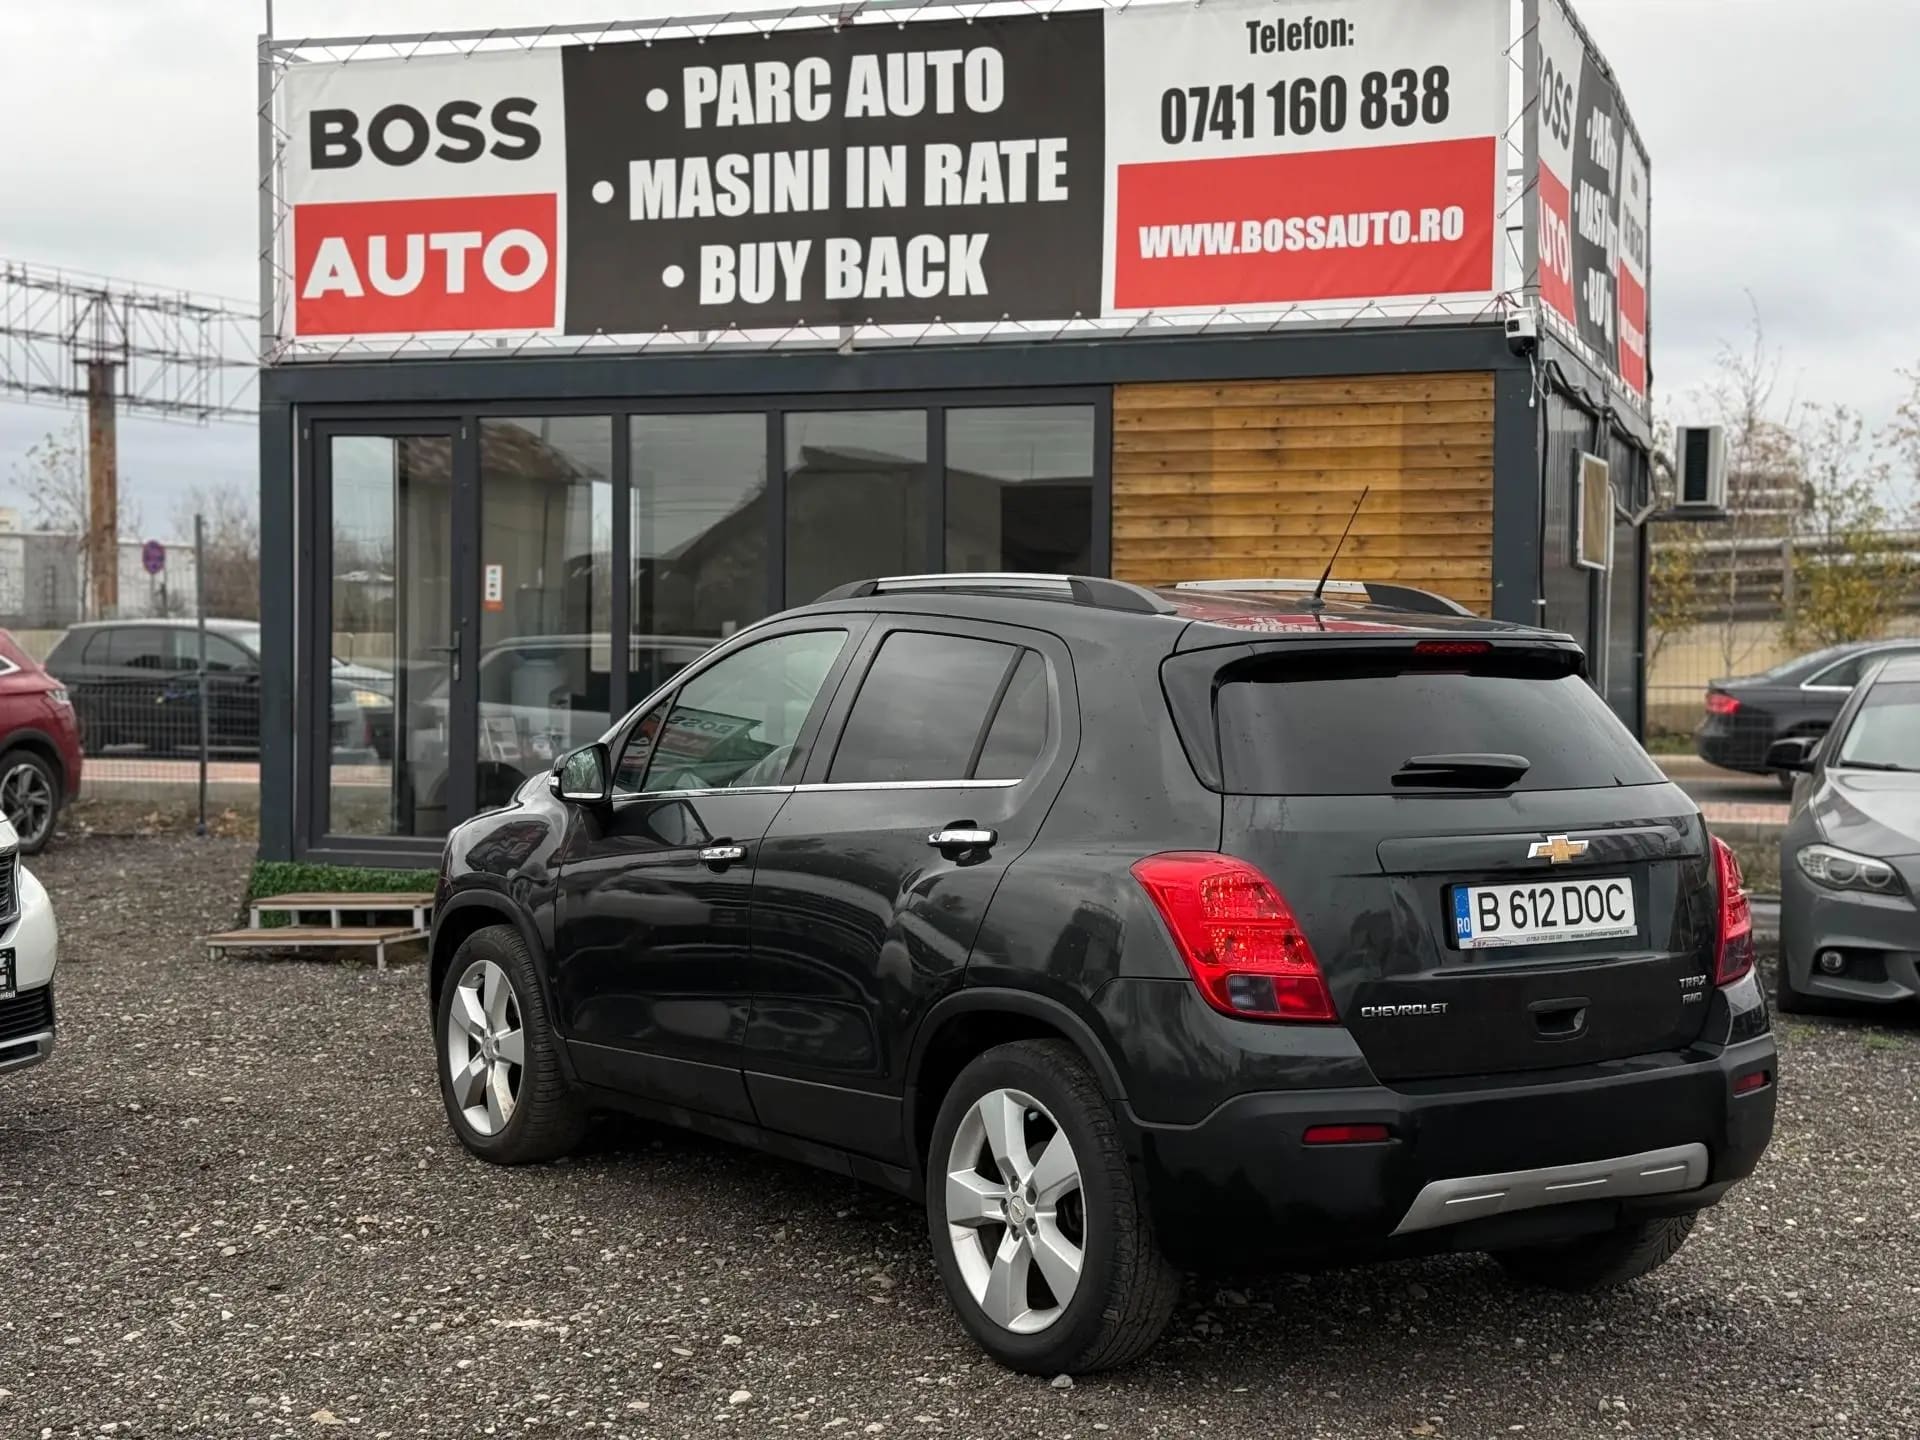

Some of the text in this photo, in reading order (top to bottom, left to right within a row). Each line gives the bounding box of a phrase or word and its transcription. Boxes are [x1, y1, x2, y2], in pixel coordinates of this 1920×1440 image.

[1245, 16, 1354, 54] Telefon:
[682, 46, 1004, 128] PARC AUTO
[1160, 65, 1450, 145] 0741 160 838
[309, 97, 541, 170] BOSS
[629, 137, 1068, 221] MASINI IN RATE
[1138, 205, 1464, 260] WWW.BOSSAUTO.RO
[301, 229, 549, 299] AUTO
[699, 233, 990, 305] BUY BACK
[1457, 917, 1472, 934] RO
[1477, 883, 1626, 932] B 612 DOC
[1361, 1002, 1449, 1018] CHEVROLET
[1679, 974, 1707, 989] TRAX
